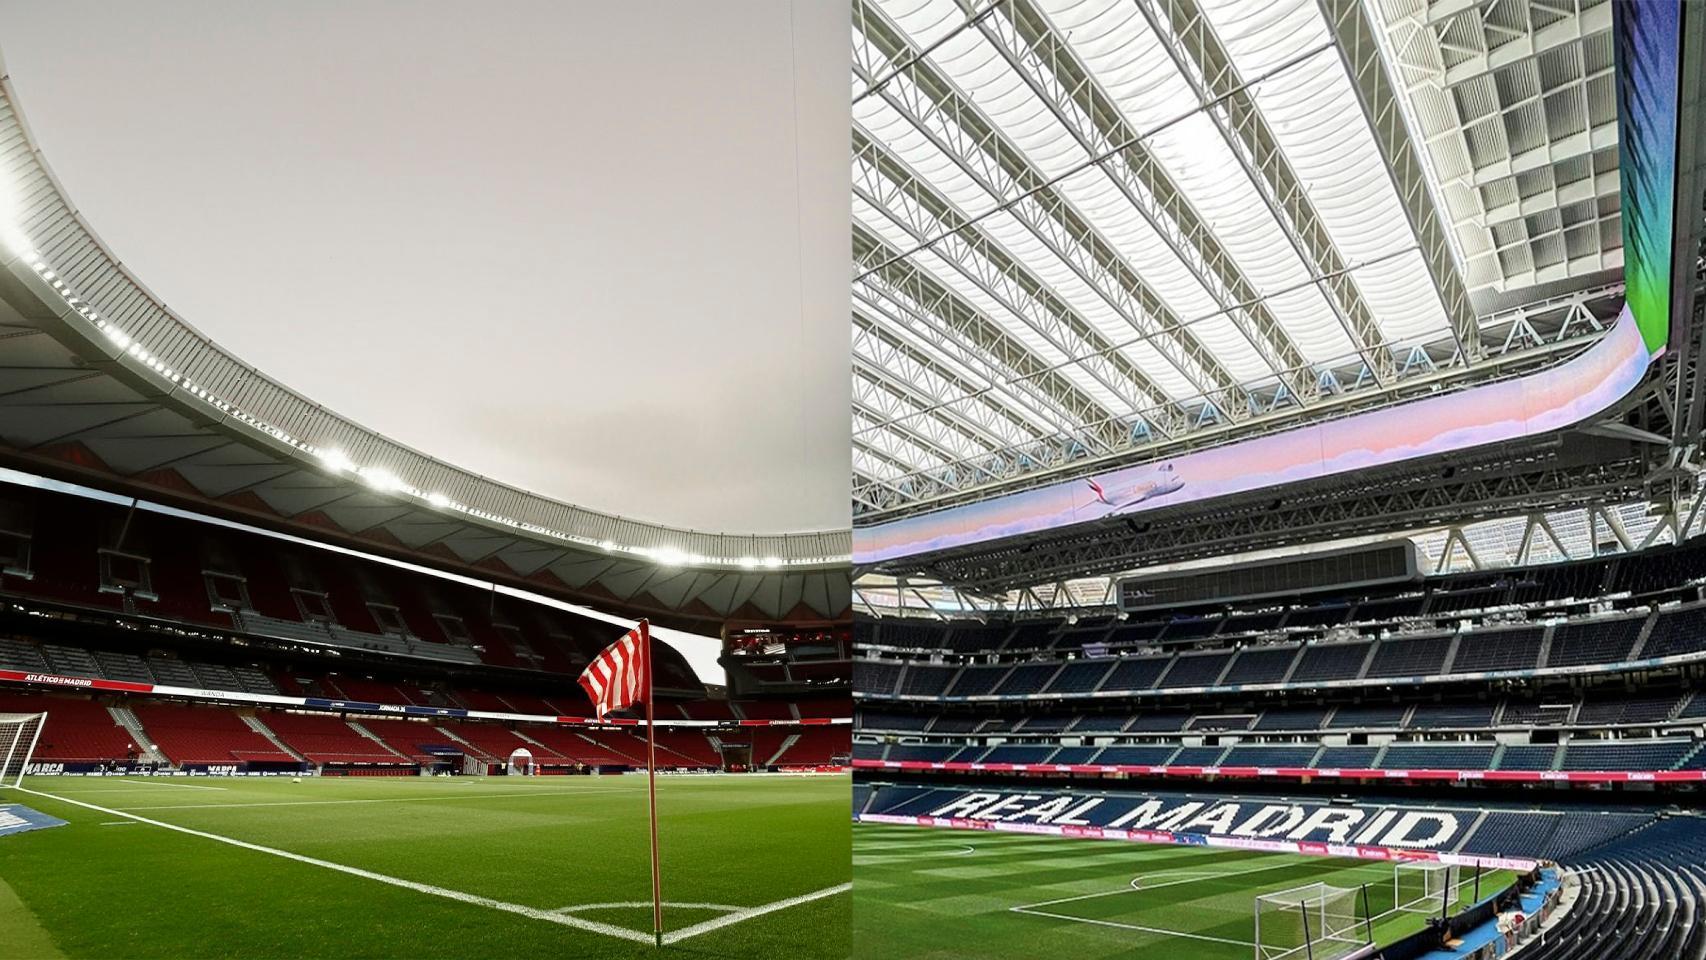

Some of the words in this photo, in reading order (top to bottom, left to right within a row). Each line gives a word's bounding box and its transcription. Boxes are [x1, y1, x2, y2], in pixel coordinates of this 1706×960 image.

[64, 678, 92, 686] MADRID
[25, 762, 65, 775] MARCA
[929, 792, 1105, 825] REAL
[1108, 799, 1459, 849] MADRID
